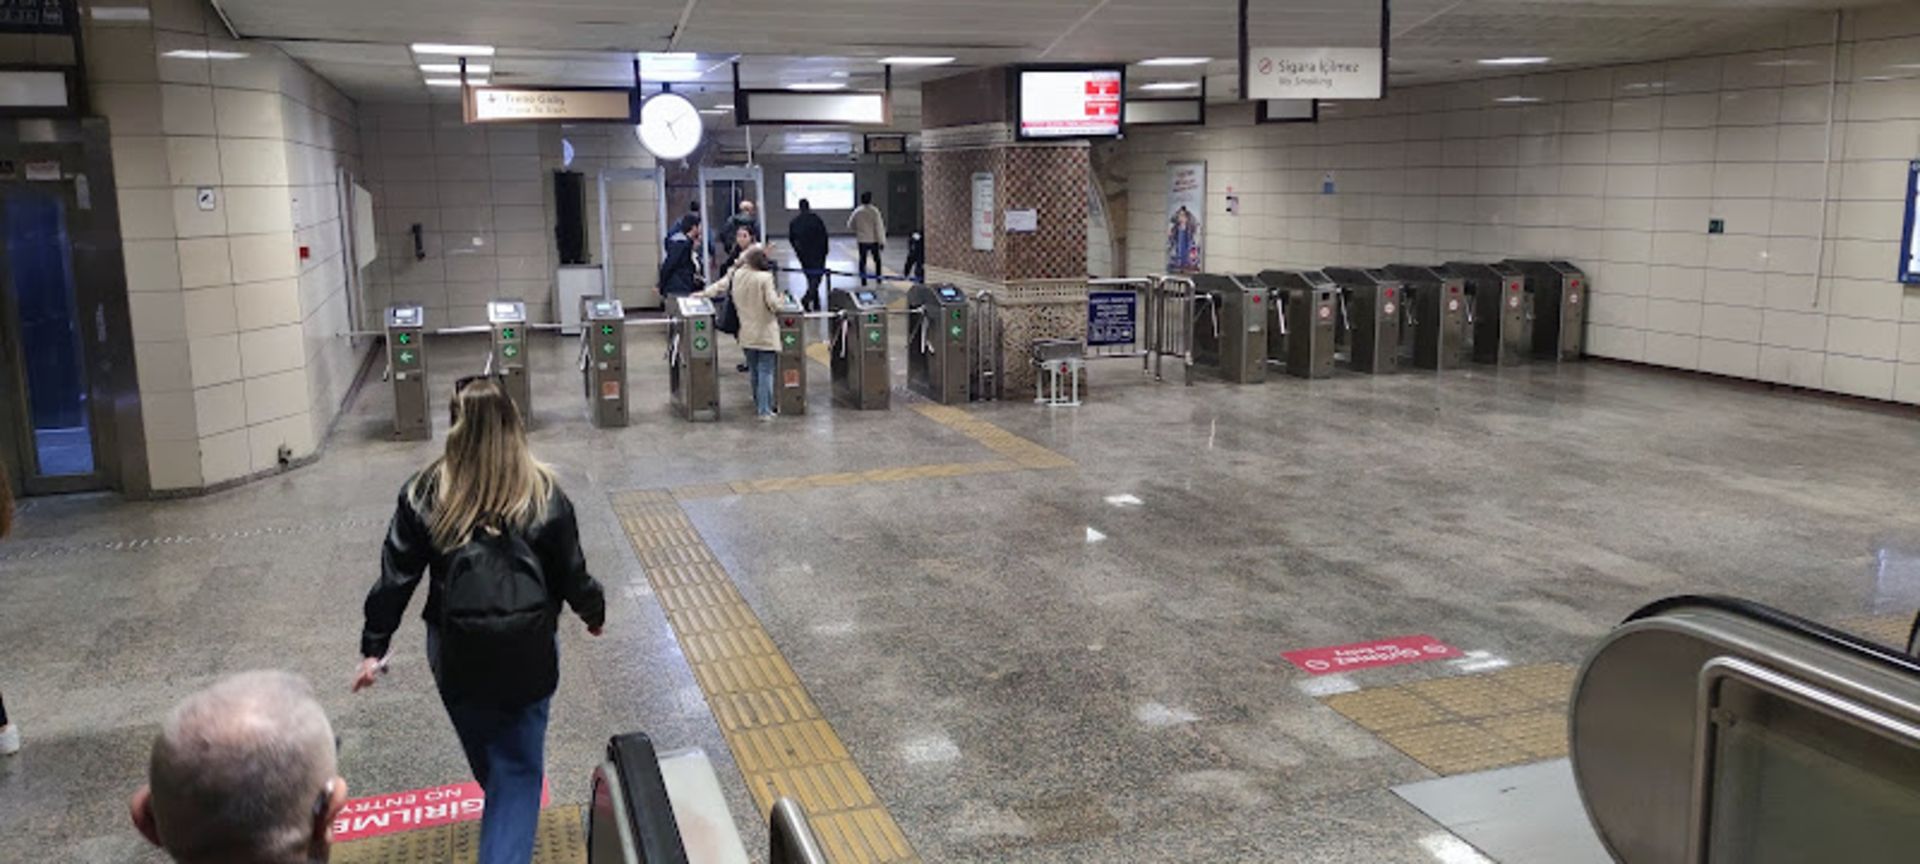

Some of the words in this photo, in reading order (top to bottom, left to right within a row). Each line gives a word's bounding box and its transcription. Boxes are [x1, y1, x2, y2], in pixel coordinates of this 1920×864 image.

[1278, 59, 1316, 75] Sigara
[1320, 57, 1360, 76] İçilmez
[1295, 77, 1333, 88] Smoking
[340, 793, 417, 814] ENTRY
[424, 787, 462, 801] NO
[332, 799, 484, 835] GİRİLME
